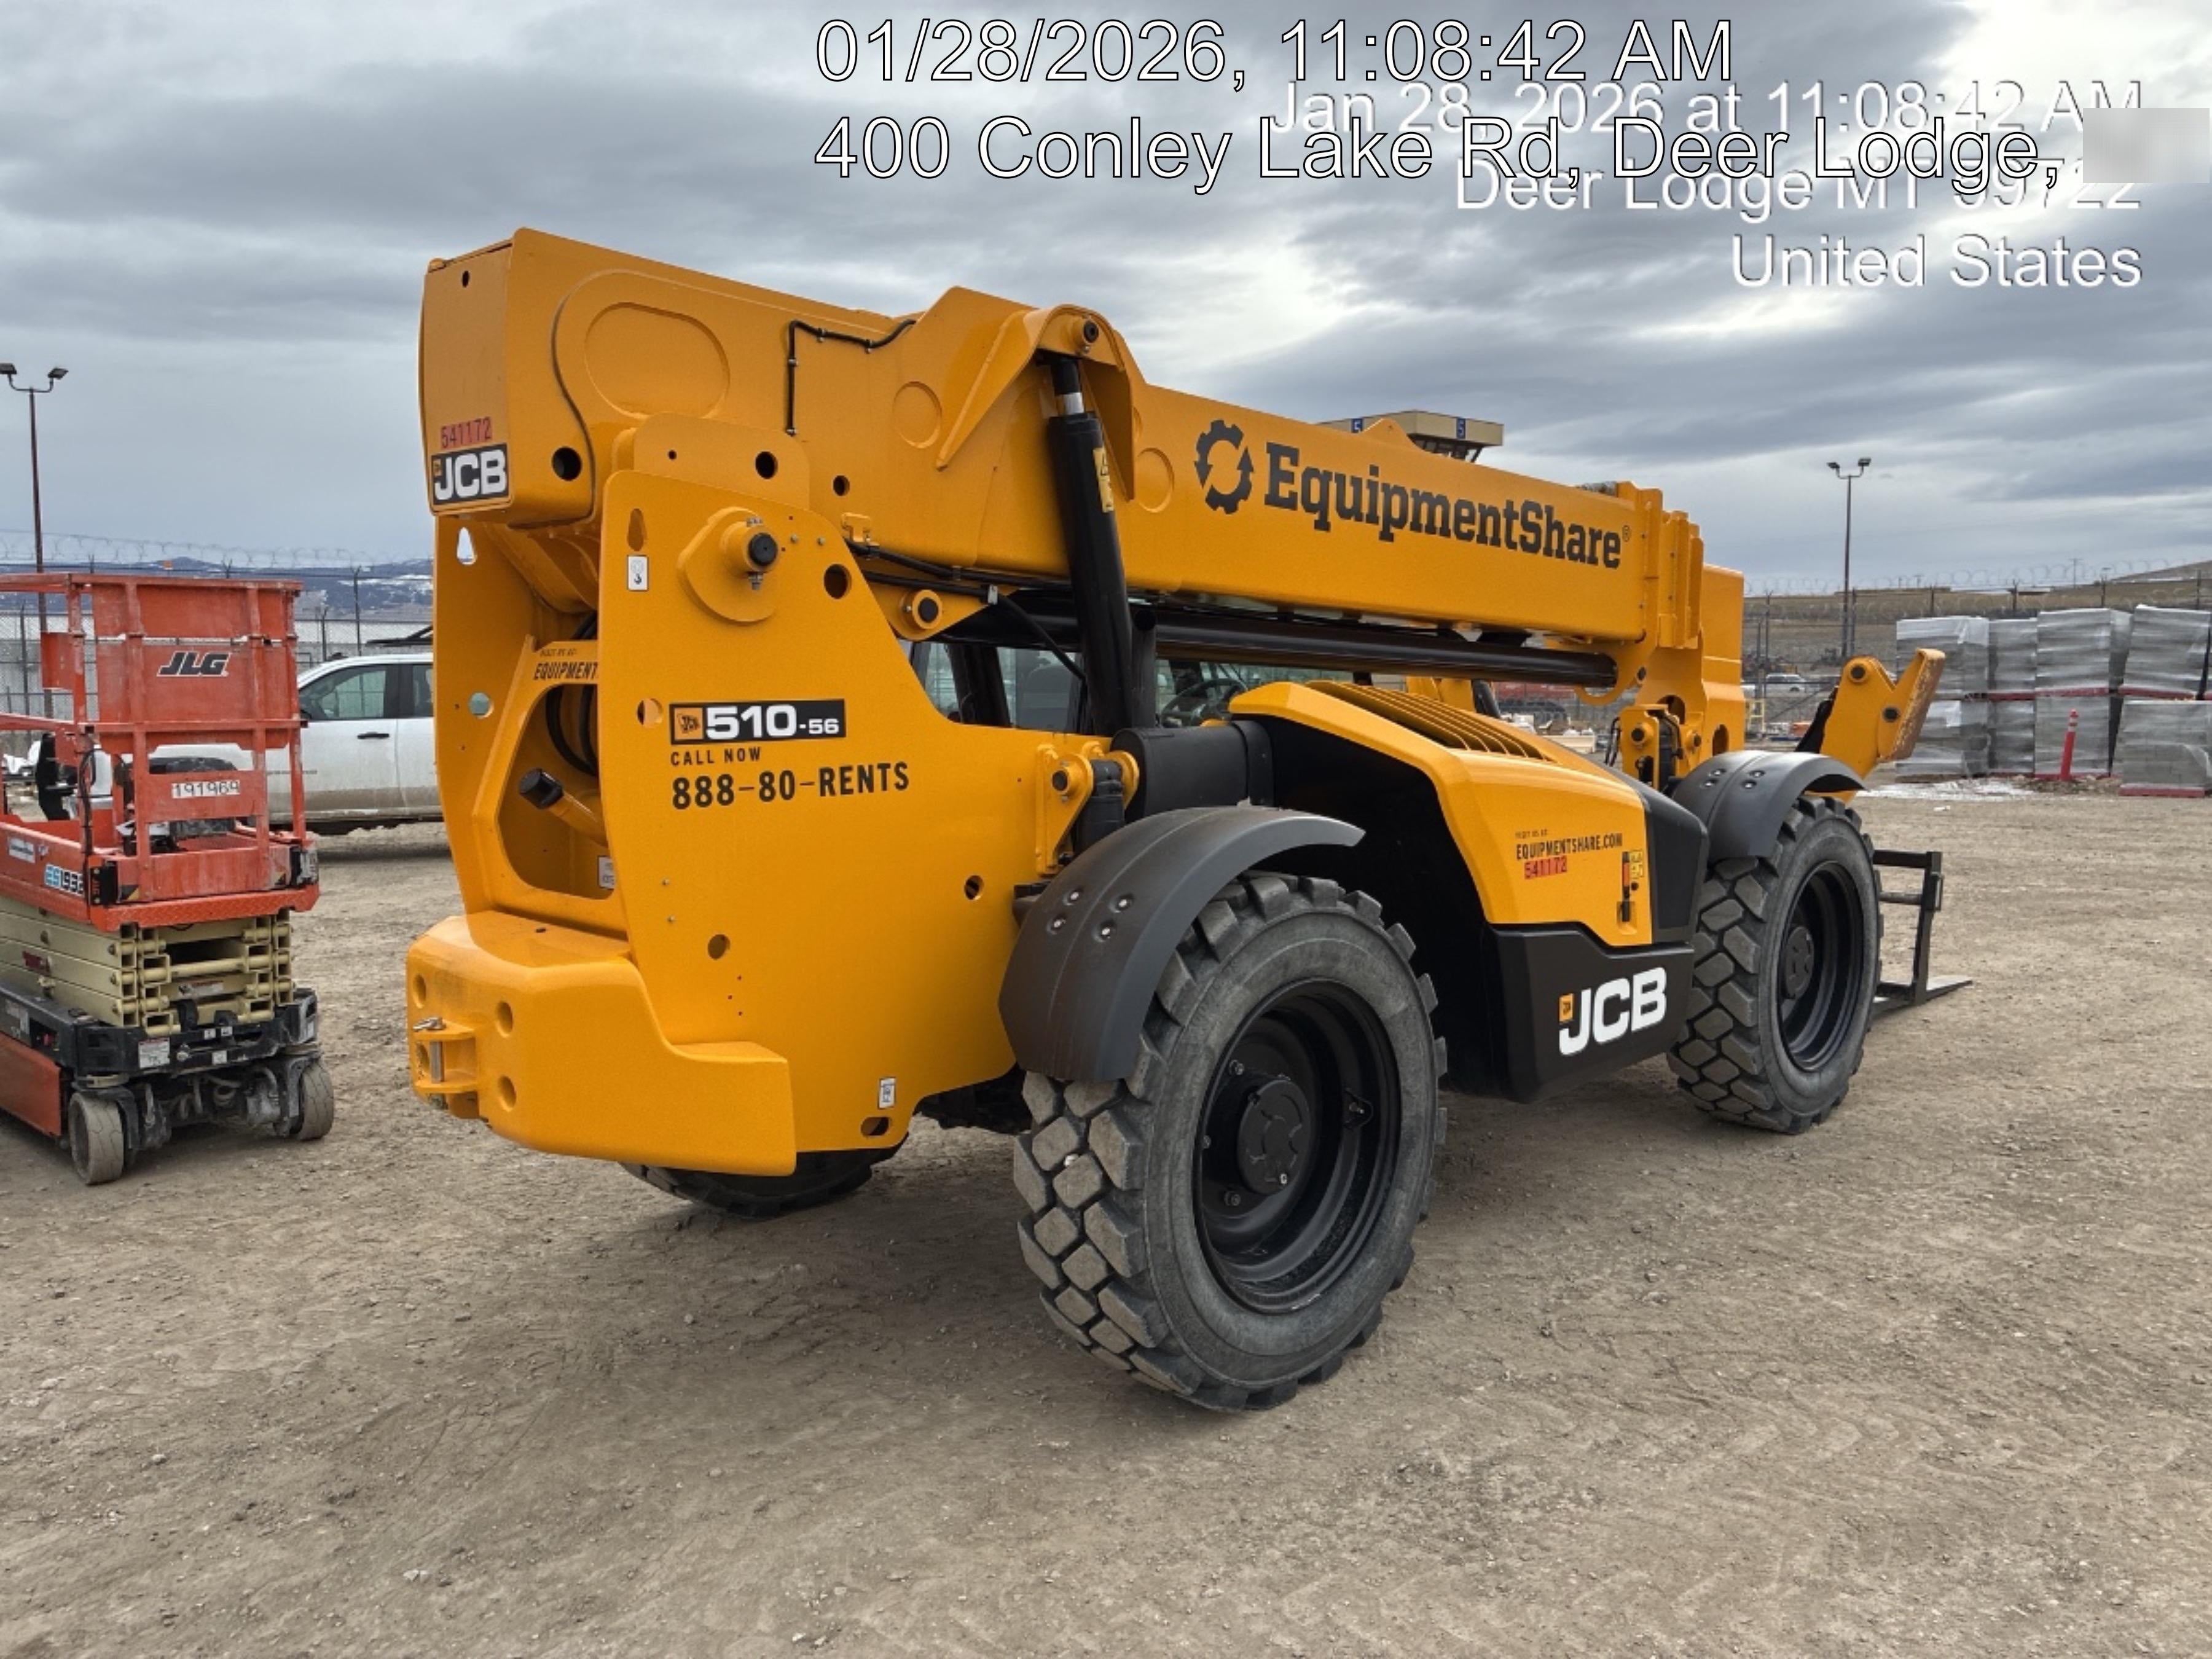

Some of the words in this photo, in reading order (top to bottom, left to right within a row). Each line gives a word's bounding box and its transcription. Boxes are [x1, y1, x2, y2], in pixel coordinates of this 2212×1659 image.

[441, 417, 492, 449] 541172
[434, 449, 508, 501] JCB
[156, 651, 231, 677] JLG
[670, 750, 714, 766] CALL
[724, 747, 761, 763] NOW
[672, 761, 909, 809] 888-80-RENTS
[1516, 833, 1623, 860] EQUIPMENTSHARE.COM
[1524, 855, 1567, 880] 541172
[1559, 967, 1666, 1056] JCB
